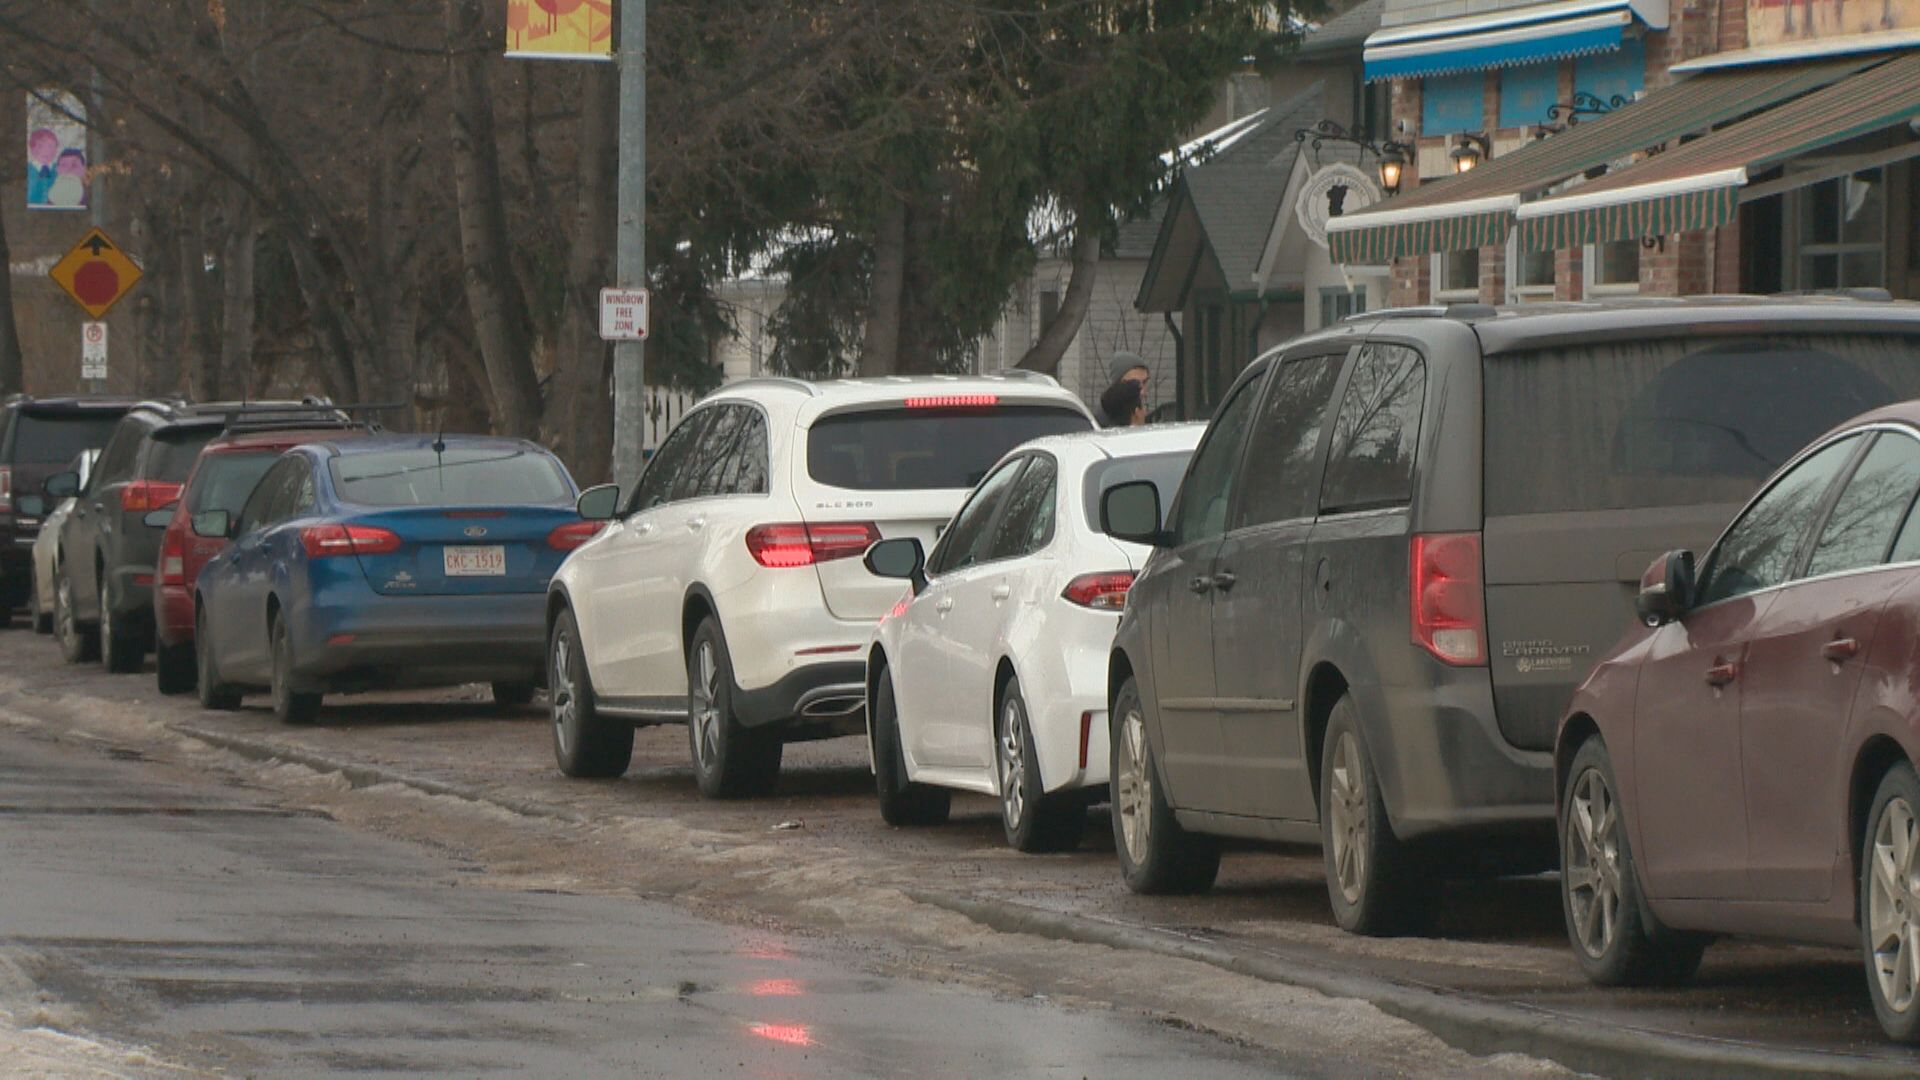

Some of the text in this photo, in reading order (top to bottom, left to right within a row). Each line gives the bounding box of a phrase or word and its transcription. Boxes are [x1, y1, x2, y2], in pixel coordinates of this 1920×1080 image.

[606, 295, 644, 304] WINDROW
[616, 307, 633, 317] FREE
[615, 321, 633, 330] ZONE
[1503, 640, 1552, 648] GRAND
[1503, 645, 1590, 656] CARAVAN
